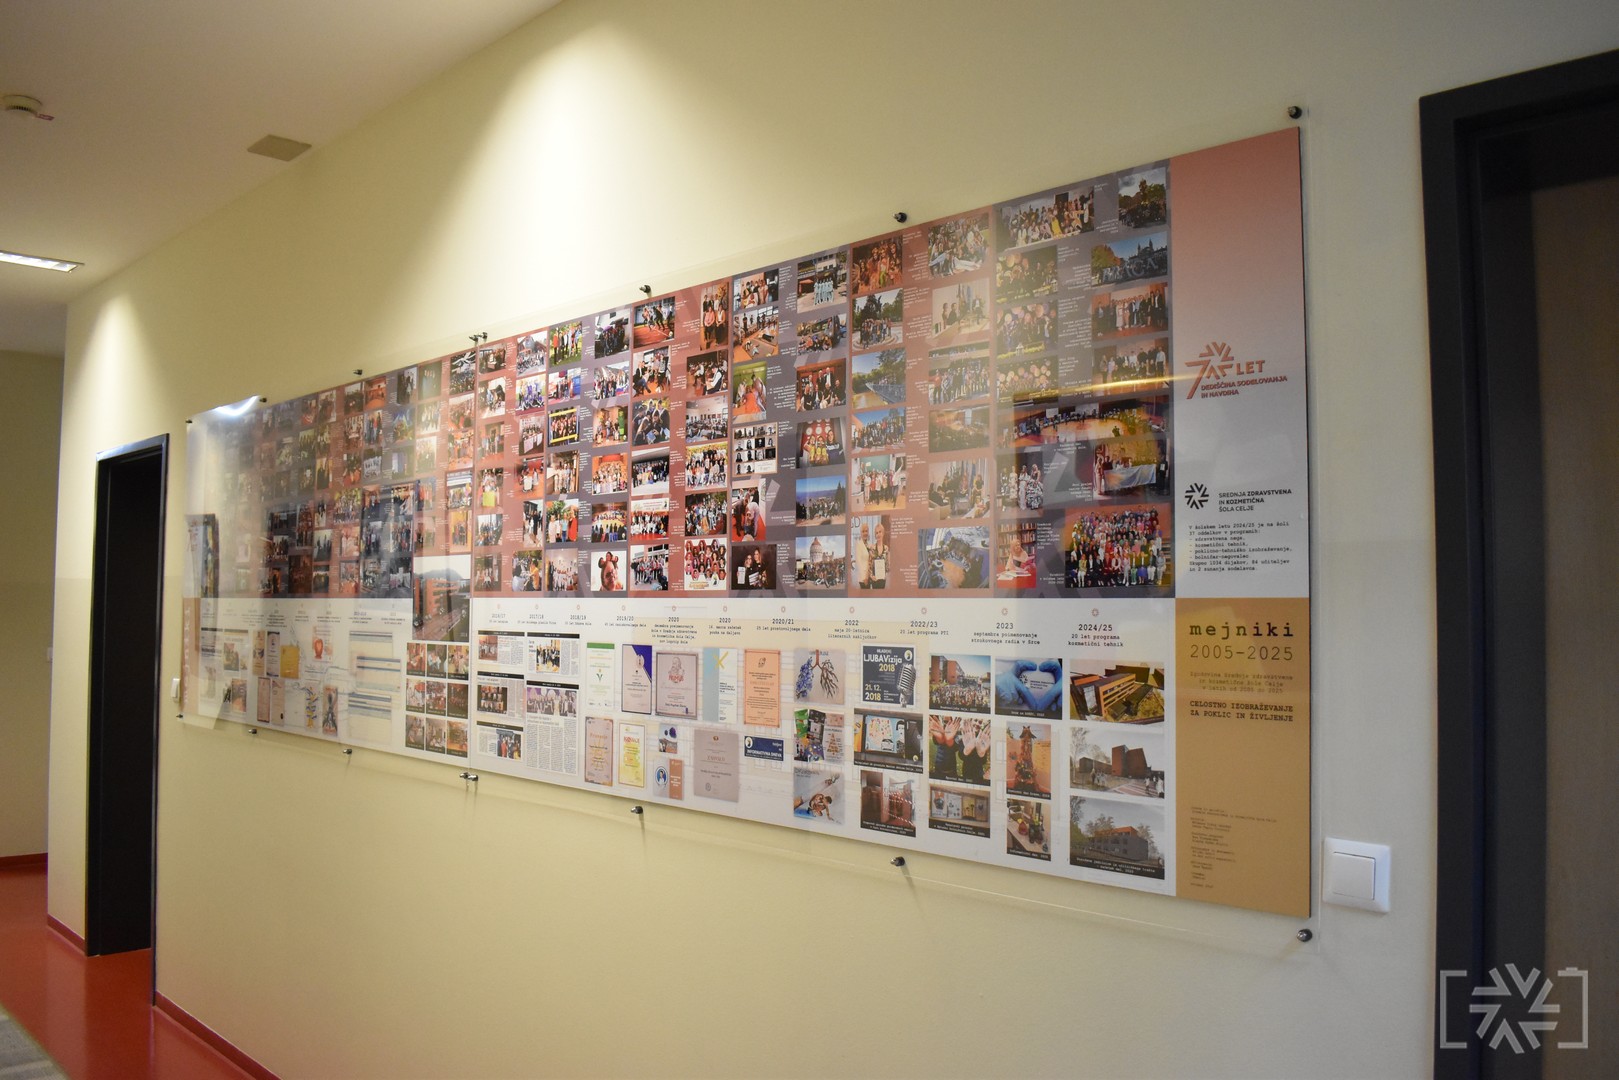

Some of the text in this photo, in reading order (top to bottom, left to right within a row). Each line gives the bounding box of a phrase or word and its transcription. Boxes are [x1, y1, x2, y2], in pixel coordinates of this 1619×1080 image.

[1236, 360, 1266, 375] LET
[1078, 624, 1113, 632] 2024/25
[1189, 622, 1294, 640] mejniki
[1231, 702, 1293, 712] IZOBRAŽEVANJE
[1250, 712, 1293, 721] ŽIVLJENJE
